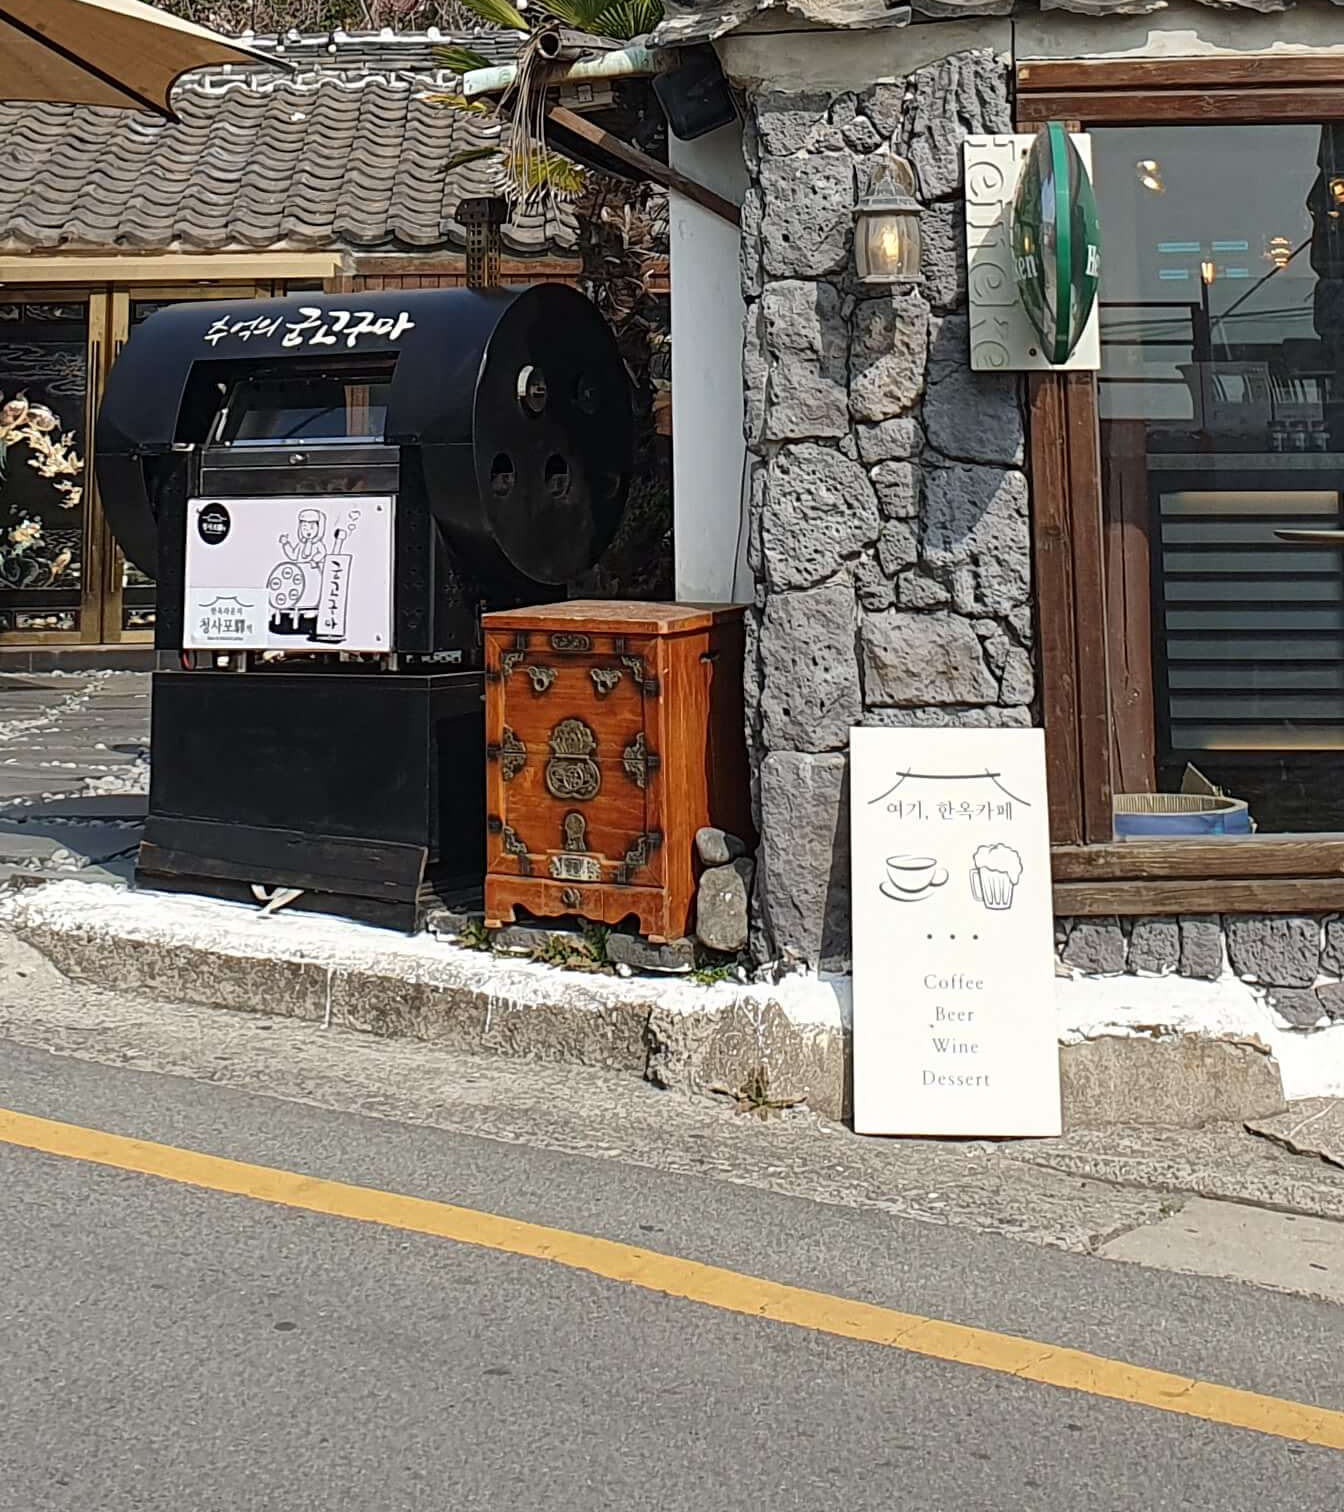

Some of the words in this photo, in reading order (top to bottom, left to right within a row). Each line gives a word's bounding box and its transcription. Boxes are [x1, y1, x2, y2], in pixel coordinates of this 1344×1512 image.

[204, 315, 283, 347] 추억의
[281, 306, 415, 348] 군고구마
[936, 800, 1013, 821] 한옥카페
[923, 973, 984, 990] Coffee
[935, 1005, 975, 1022] Beer
[931, 1037, 979, 1054] Wine
[921, 1069, 991, 1087] Dessert
